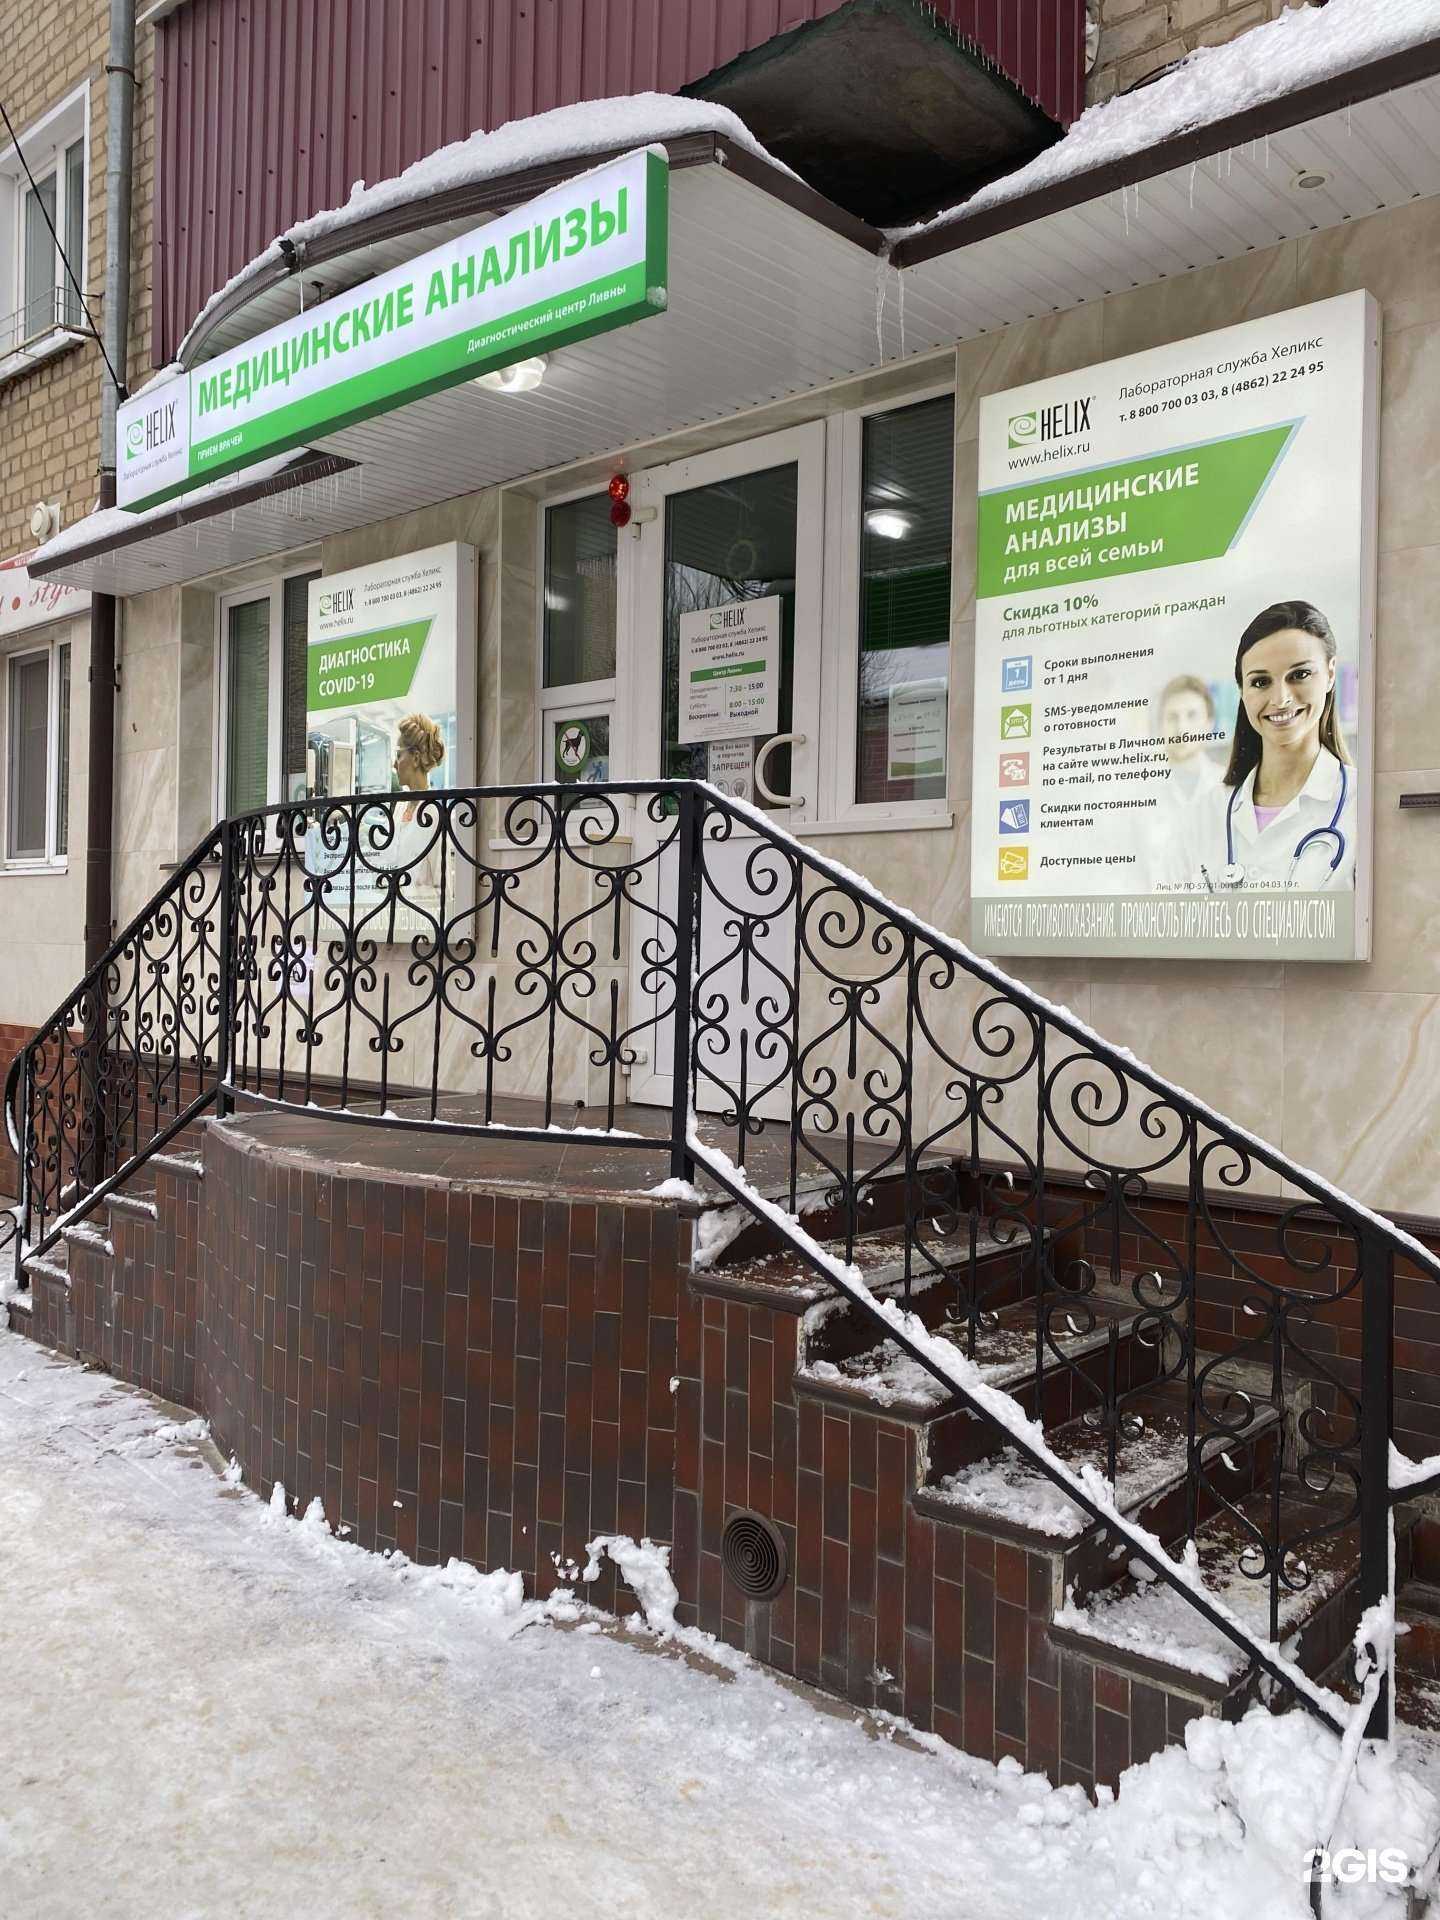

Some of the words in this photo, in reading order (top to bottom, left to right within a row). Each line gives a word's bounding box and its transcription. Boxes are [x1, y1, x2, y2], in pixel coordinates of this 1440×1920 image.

[199, 283, 413, 416] МЕДИЦИНСКИЕ
[425, 187, 627, 316] АНАЛИЗЫ
[467, 310, 553, 354] Диагностический
[555, 300, 586, 320] центр
[588, 283, 627, 306] Ливны
[1119, 366, 1213, 400] Лабораторная
[1217, 351, 1268, 375] служба
[1271, 337, 1324, 360] Хеликс
[1119, 413, 1128, 422] т.
[1129, 409, 1137, 420] 8
[1138, 403, 1159, 418] 800
[1161, 398, 1182, 412] 700
[1184, 394, 1198, 406] 03
[1201, 389, 1219, 402] 03,
[1221, 386, 1228, 396] 8
[1231, 374, 1269, 396] (4862)
[1272, 372, 1287, 384] 22
[1290, 366, 1305, 379] 24
[1308, 361, 1324, 374] 95
[146, 401, 175, 452] HELIX
[1041, 397, 1091, 442] HELIX
[1008, 441, 1090, 470] www.helix.ru
[1005, 462, 1199, 524] МЕДИЦИНСКИЕ
[1004, 511, 1127, 556] АНАЛИЗЫ
[1003, 561, 1040, 584] для
[1045, 546, 1092, 574] всей
[1098, 538, 1164, 564] семьи
[333, 588, 354, 614] HELIX
[1003, 600, 1060, 622] Скидка
[1063, 594, 1099, 612] 10%
[723, 607, 744, 628] HELIX
[1002, 626, 1025, 641] для
[1027, 618, 1088, 636] льготных
[1090, 603, 1161, 625] категорий
[1164, 595, 1226, 616] граждан
[319, 637, 410, 674] ДИАГНОСТИКА
[1044, 656, 1079, 672] Сроки
[1081, 647, 1154, 666] выполнения
[319, 672, 375, 696] COVID-19
[748, 682, 764, 691] 15:00
[1043, 676, 1057, 686] от
[1059, 673, 1064, 684] 1
[1067, 671, 1088, 686] дня
[748, 698, 765, 706] 15:00
[1044, 697, 1149, 719] SMS-уведомление
[1043, 724, 1050, 732] о
[1053, 717, 1116, 732] готовности
[1043, 741, 1107, 757] Результаты
[1109, 741, 1116, 750] в
[1118, 735, 1165, 750] Личном
[1168, 730, 1226, 746] кабинете
[1043, 761, 1056, 772] на
[1058, 757, 1088, 770] сайте
[1091, 753, 1169, 768] www.helix.ru,
[1042, 777, 1056, 787] по
[1058, 771, 1095, 785] e-mail,
[1097, 772, 1112, 783] по
[1114, 767, 1172, 783] телефону
[1040, 801, 1081, 814] Скидки
[1084, 798, 1157, 811] постоянным
[1040, 817, 1094, 829] клиентам
[1040, 855, 1103, 868] Доступные
[1105, 854, 1136, 865] цены
[984, 903, 1023, 937] ИМЕЮТСЯ
[1026, 902, 1117, 937] ПРОТИВОПОКАЗАНИЯ.
[1121, 896, 1232, 938] ПРОКОНСУЛЬТИРУЙТЕСЬ
[1235, 901, 1249, 938] СО
[1253, 899, 1336, 945] СПЕЦИАЛИСТОМ
